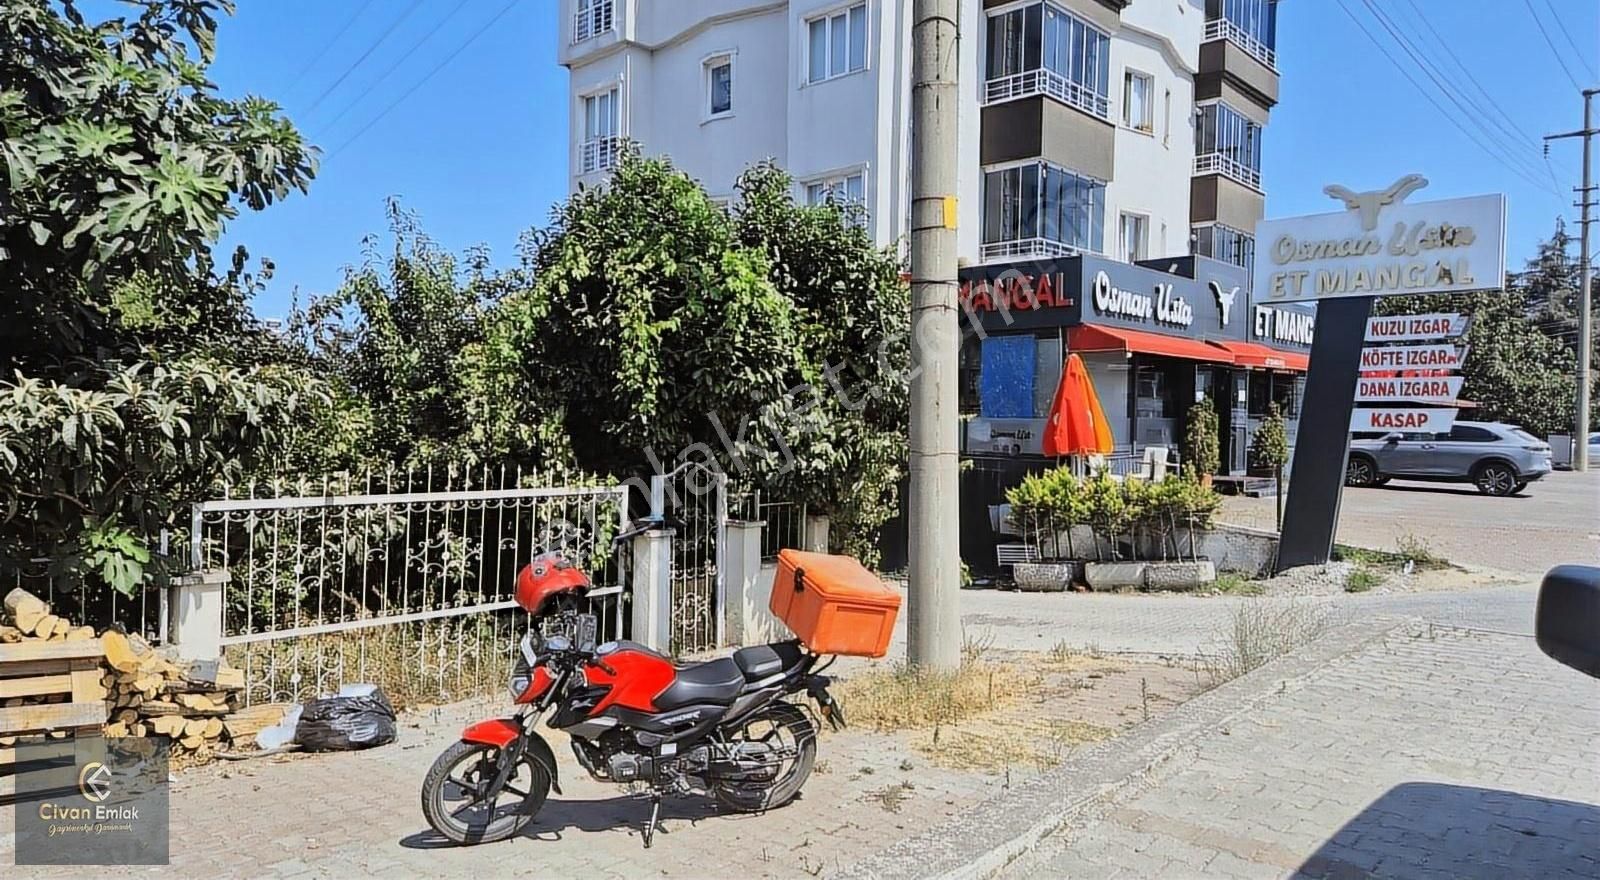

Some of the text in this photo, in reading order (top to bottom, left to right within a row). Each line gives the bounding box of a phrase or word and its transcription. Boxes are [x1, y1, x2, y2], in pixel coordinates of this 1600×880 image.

[1271, 233, 1382, 265] Osman
[1270, 258, 1475, 298] ET MANGAL
[1092, 270, 1193, 326] Osman Usta
[1255, 304, 1273, 337] ET
[1371, 320, 1406, 336] KUZU
[1362, 349, 1403, 366] KÖFTE
[1360, 381, 1450, 397] DANA IZGARA
[1371, 412, 1428, 428] KASAP
